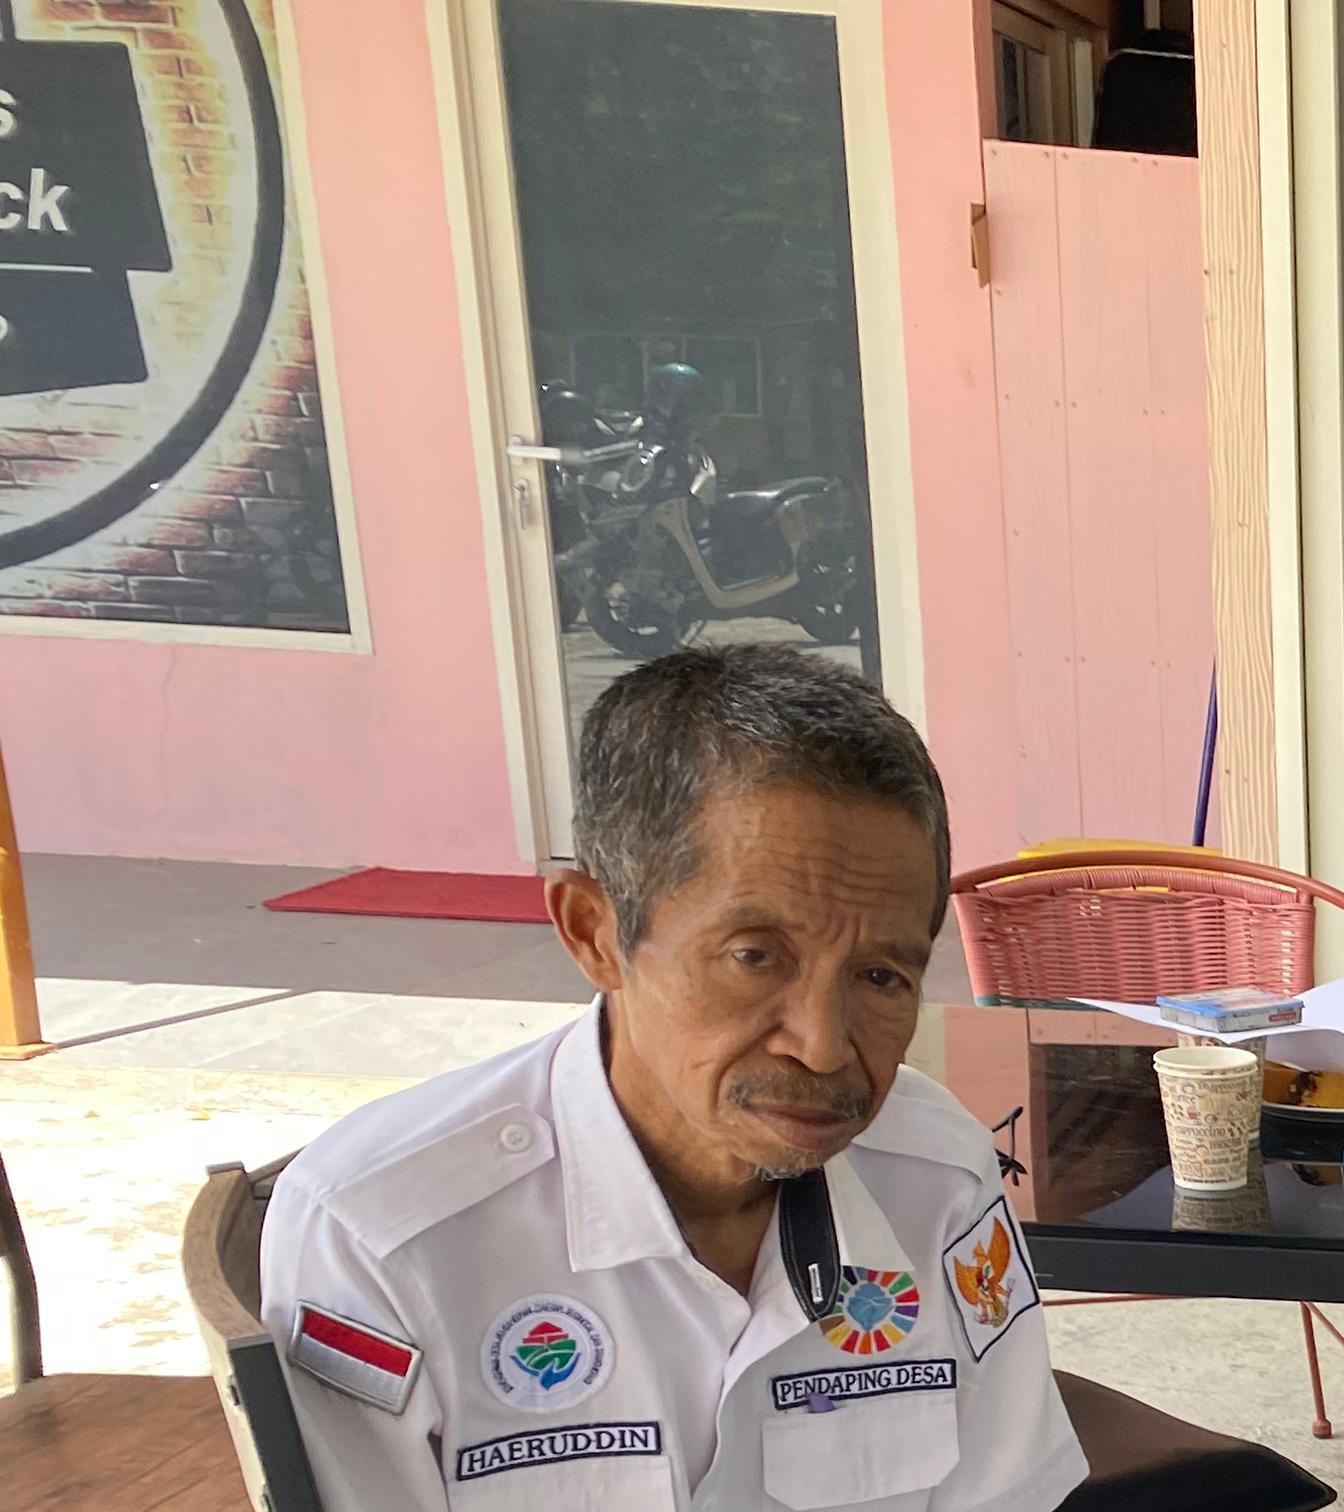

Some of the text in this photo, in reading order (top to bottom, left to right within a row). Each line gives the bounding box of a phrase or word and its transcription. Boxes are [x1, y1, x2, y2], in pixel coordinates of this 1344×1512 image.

[780, 1365, 949, 1402] PENDAPING DESA
[467, 1429, 650, 1473] HAERUDDIN
